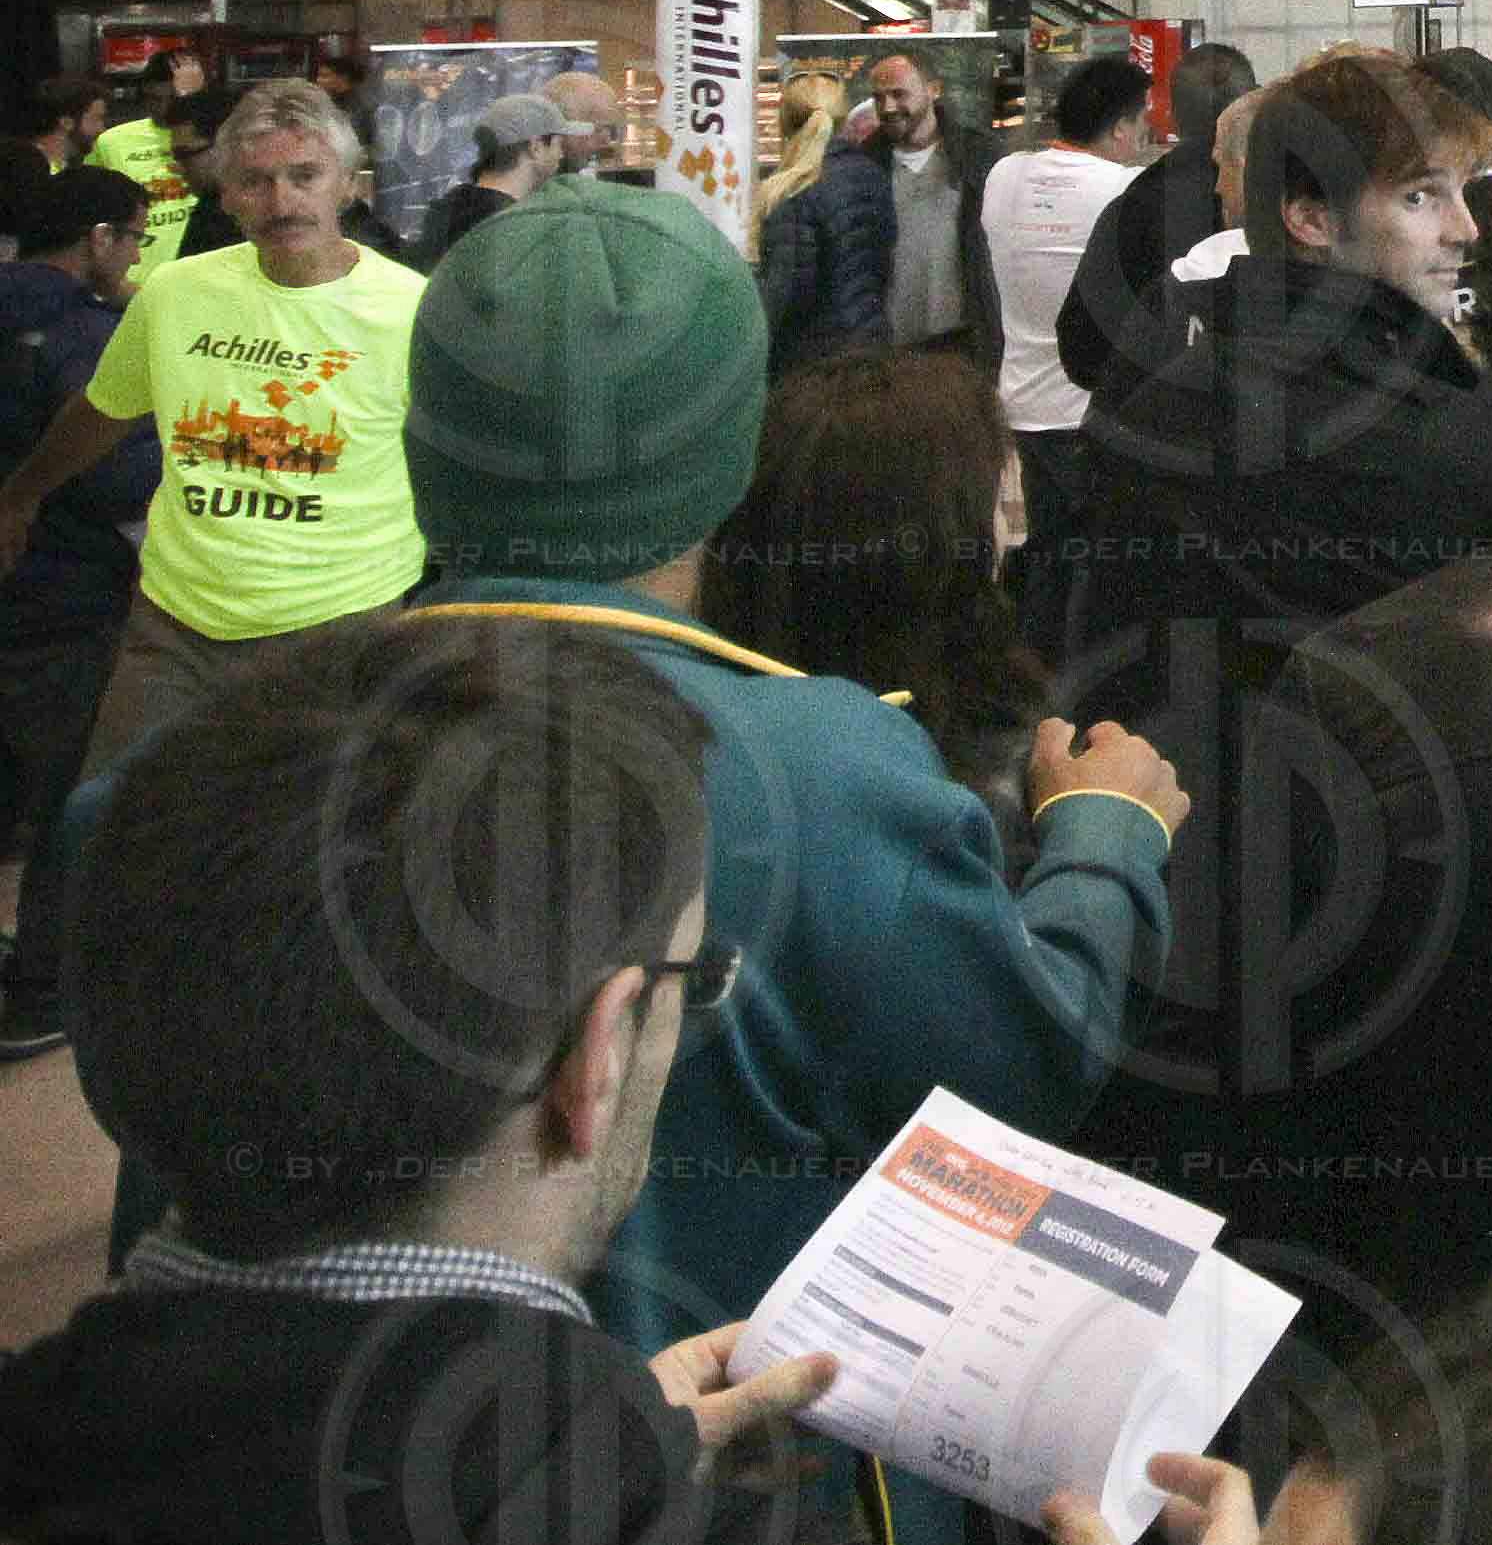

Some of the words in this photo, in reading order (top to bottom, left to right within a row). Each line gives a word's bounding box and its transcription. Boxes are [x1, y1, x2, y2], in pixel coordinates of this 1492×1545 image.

[186, 332, 314, 372] Achilles
[183, 485, 324, 524] GUIDE
[1038, 1217, 1129, 1273] REGISTRATION
[1126, 1255, 1171, 1287] FORM
[930, 1436, 992, 1483] 3253
